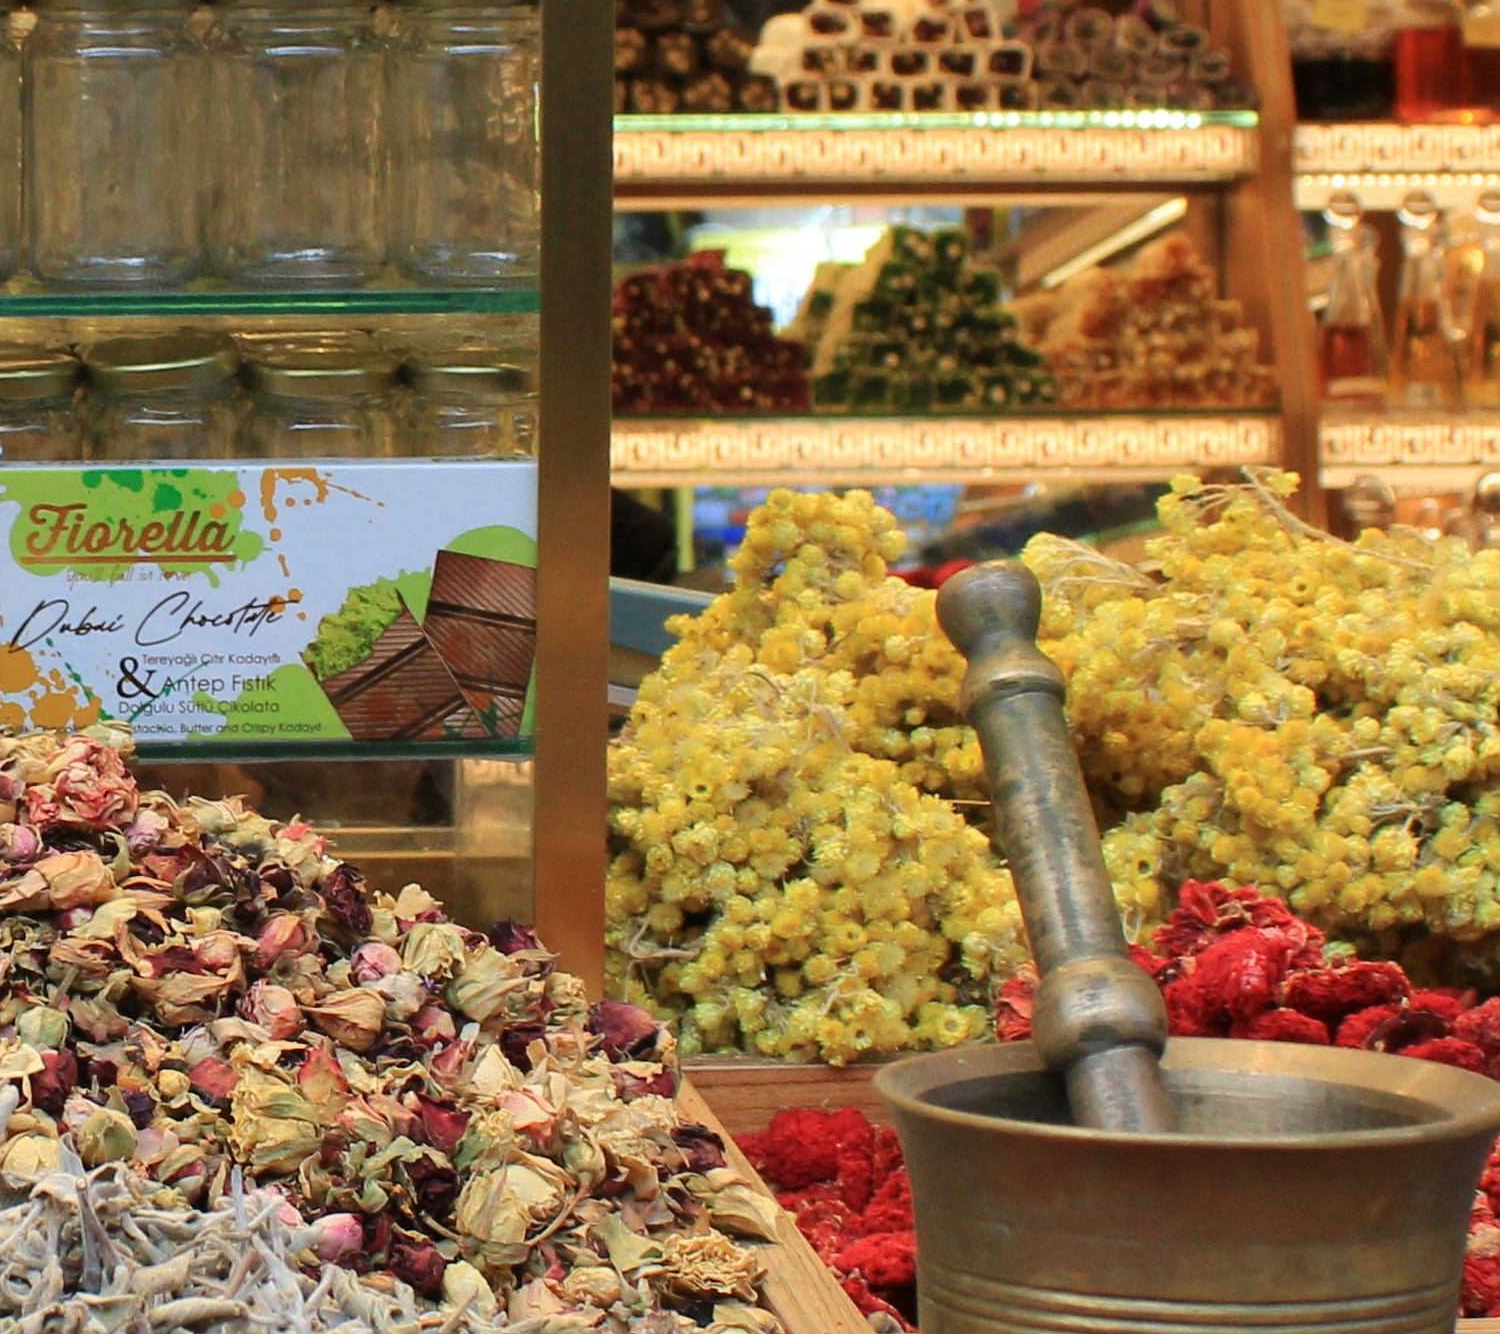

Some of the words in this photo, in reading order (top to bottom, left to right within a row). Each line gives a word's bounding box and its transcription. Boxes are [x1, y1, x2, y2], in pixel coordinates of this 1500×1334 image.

[26, 503, 237, 557] Fiorella
[8, 599, 125, 654] Dubai
[134, 590, 300, 647] Chocolate
[142, 653, 198, 667] Tereyağlı
[116, 656, 160, 699] &
[161, 675, 225, 695] Antep
[232, 675, 277, 691] Fıstık
[119, 700, 175, 716] Dolgulu
[178, 700, 214, 714] Sütlü
[217, 700, 280, 716] Çikolata
[180, 722, 213, 733] Butter
[215, 722, 239, 733] and
[242, 722, 277, 736] Crispy
